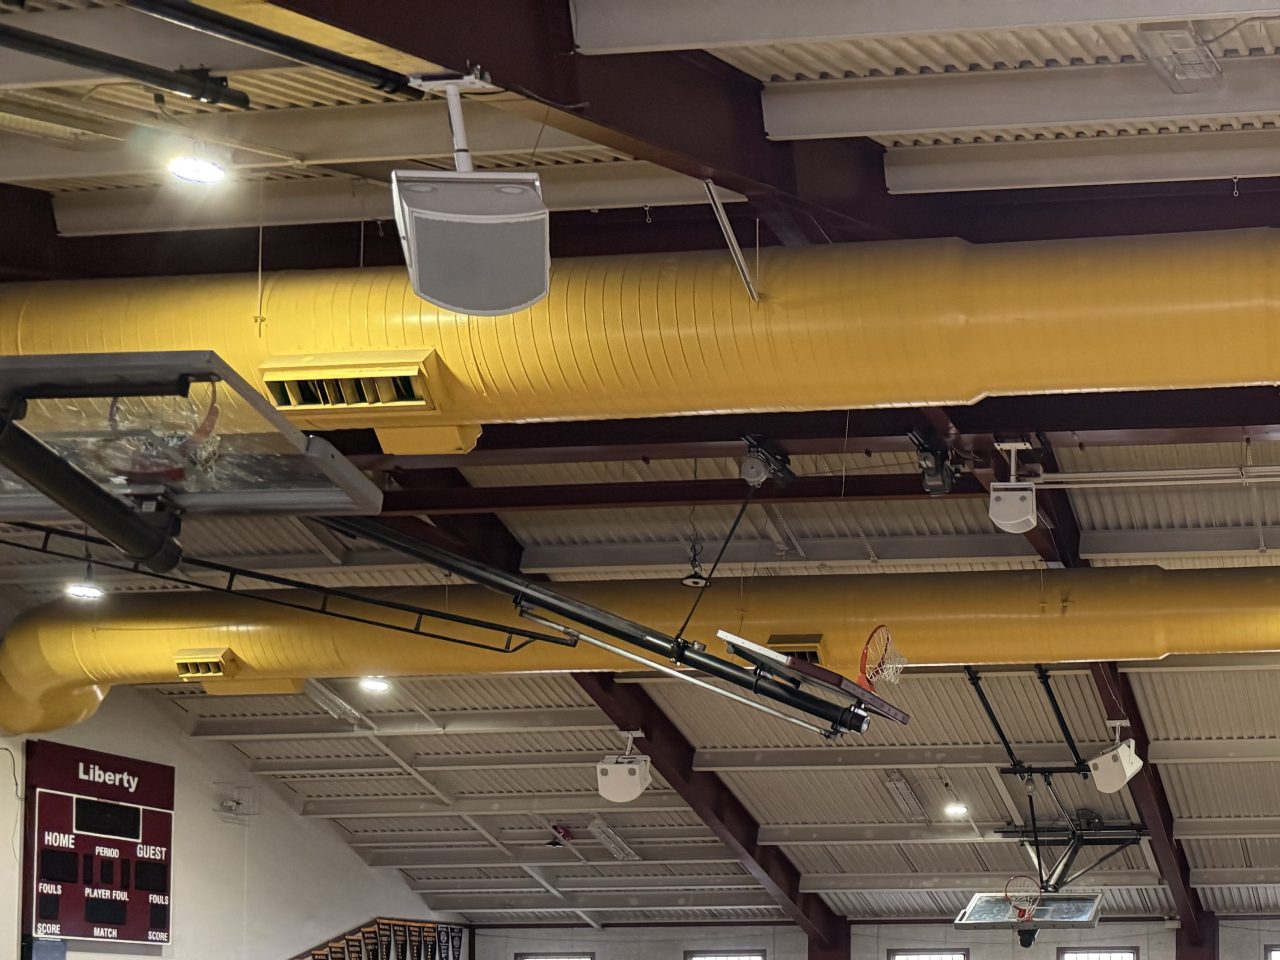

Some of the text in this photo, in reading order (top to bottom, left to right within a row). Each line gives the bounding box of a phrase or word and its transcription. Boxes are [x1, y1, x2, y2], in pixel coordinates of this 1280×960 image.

[78, 762, 139, 793] Liberty
[44, 831, 76, 849] HOME
[95, 846, 120, 858] PERIOD
[136, 844, 167, 861] GUEST
[38, 883, 62, 895] FOULS
[84, 887, 130, 901] PLAYER FOUL
[149, 894, 169, 905] FOULS
[37, 923, 61, 935] SCORE
[93, 927, 118, 938] MATCH
[148, 931, 169, 942] SCORE
